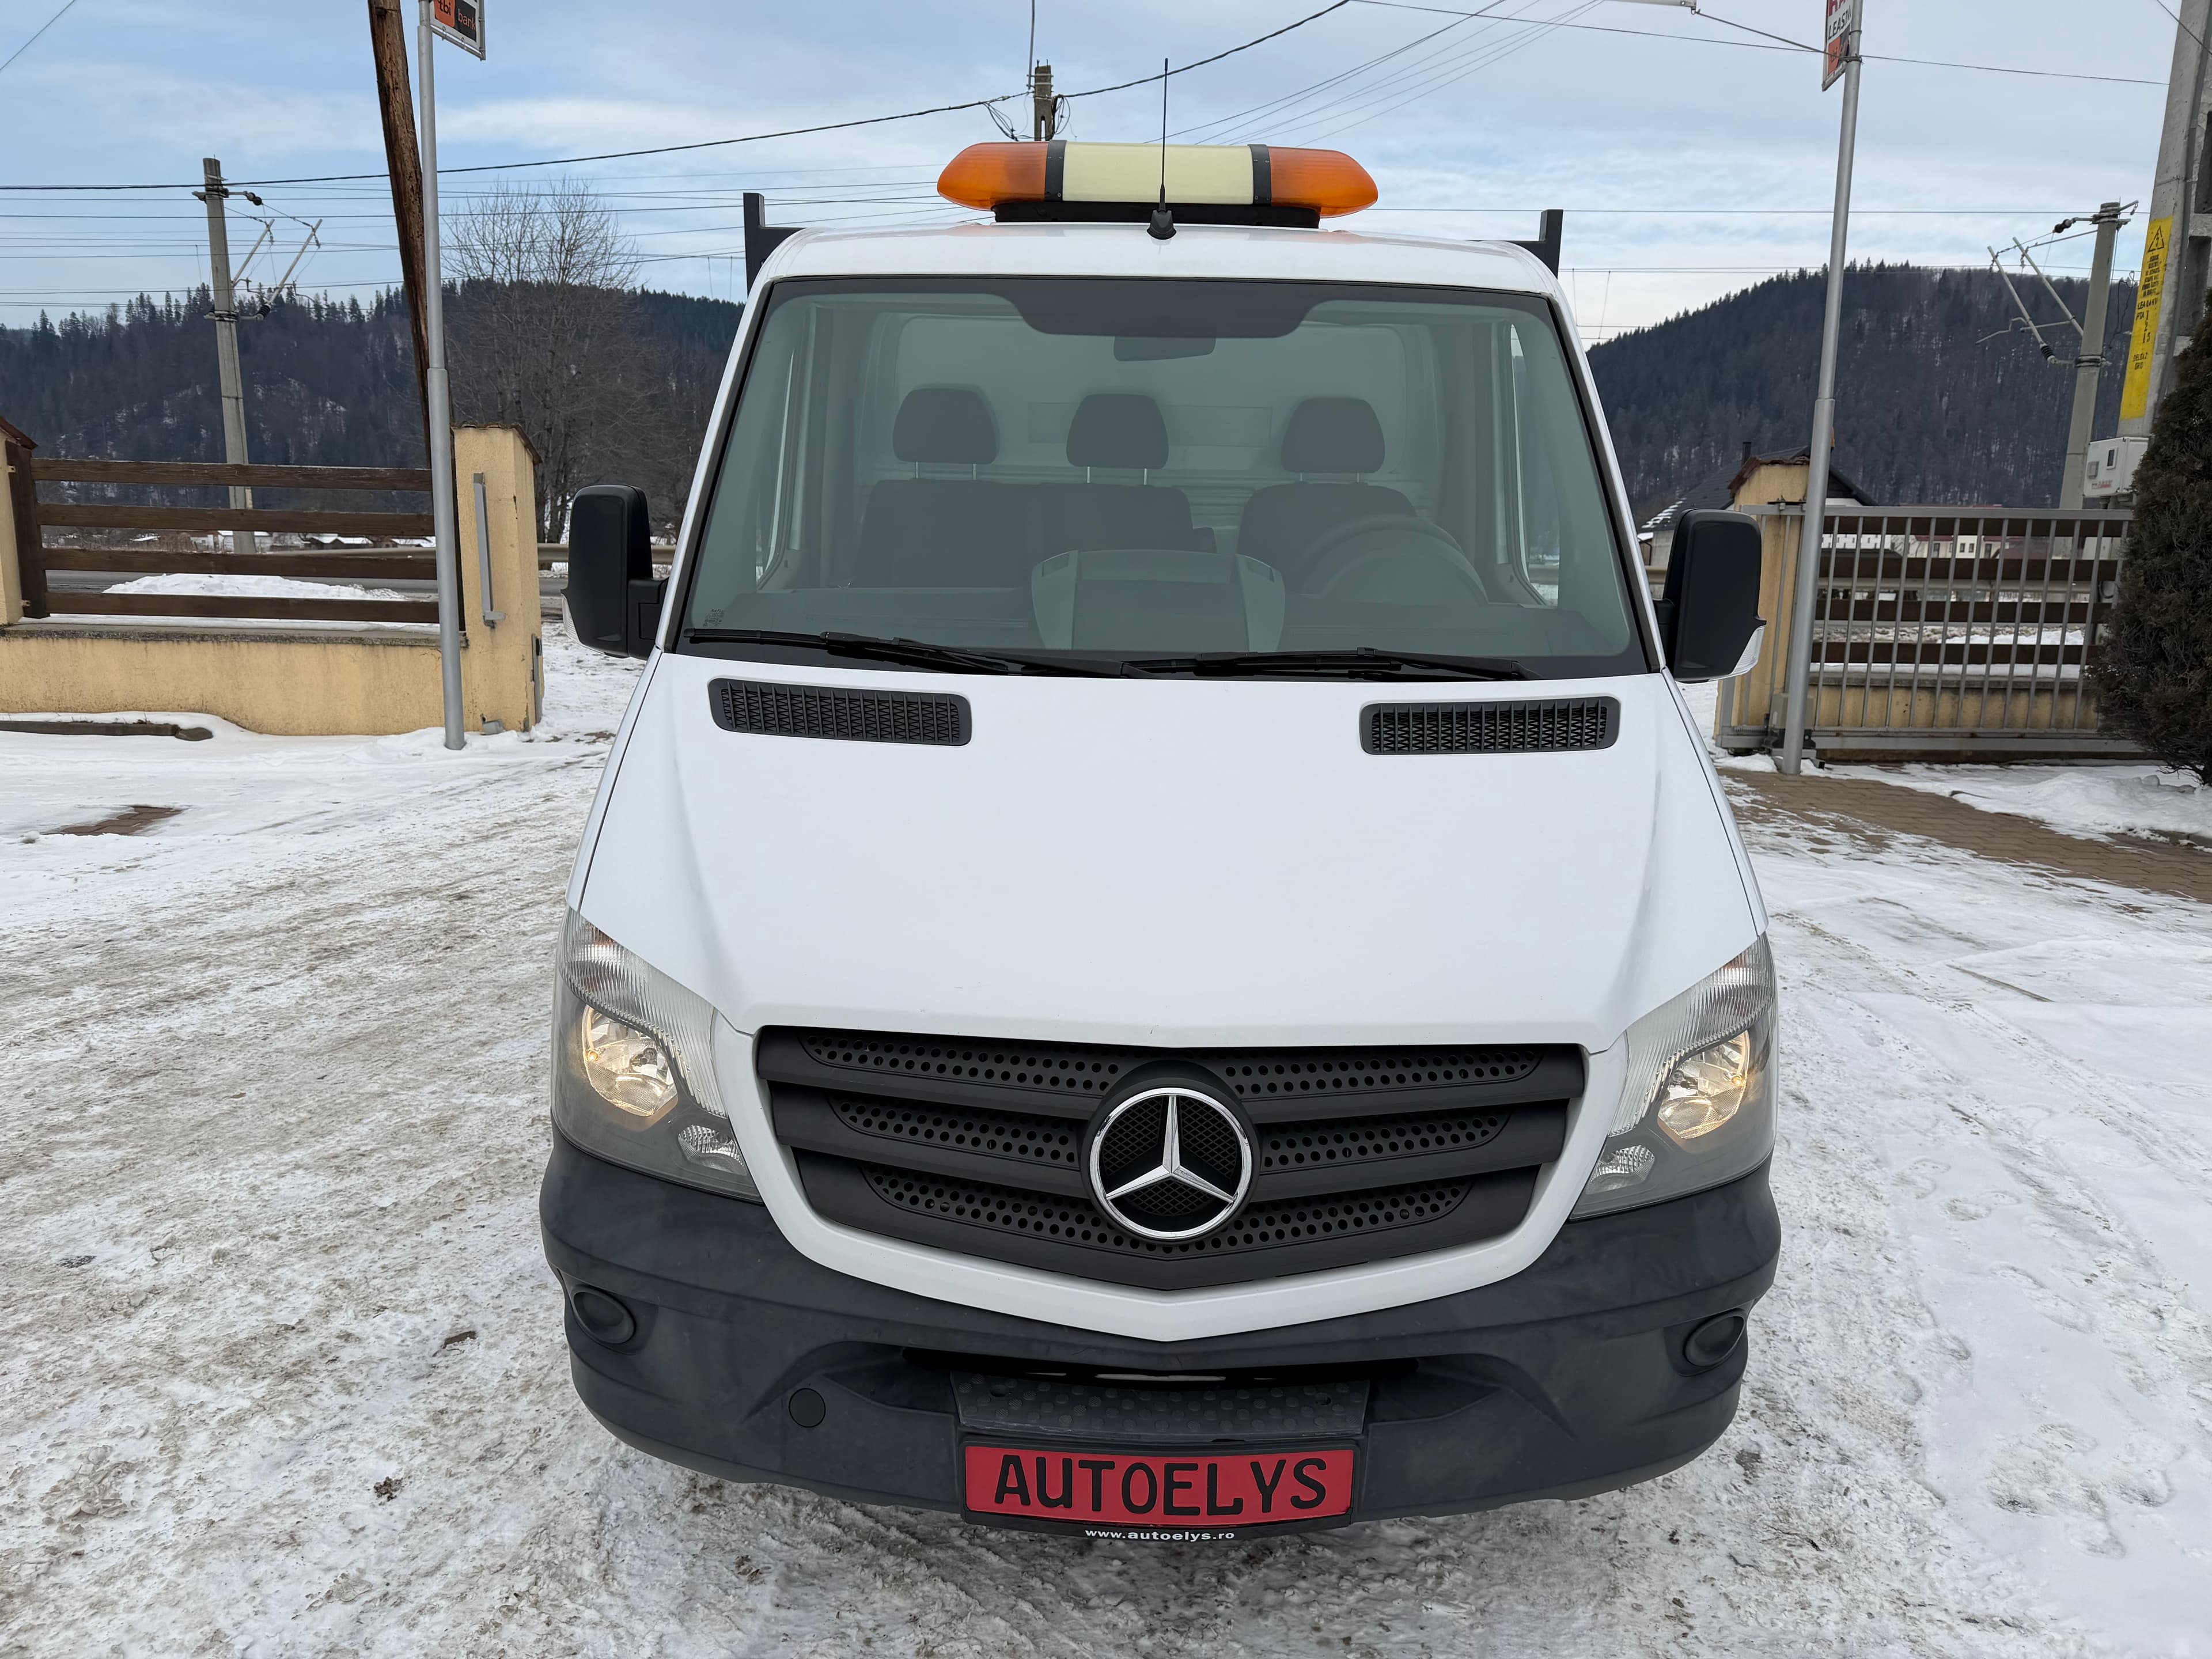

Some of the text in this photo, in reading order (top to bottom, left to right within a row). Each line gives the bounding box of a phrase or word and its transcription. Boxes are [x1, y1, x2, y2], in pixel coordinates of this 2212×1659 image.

[438, 0, 476, 31] tbi bank
[1828, 5, 1851, 40] LEASIN
[994, 1455, 1327, 1516] AUTOELYS
[1085, 1529, 1235, 1542] www.autoelys.ro
